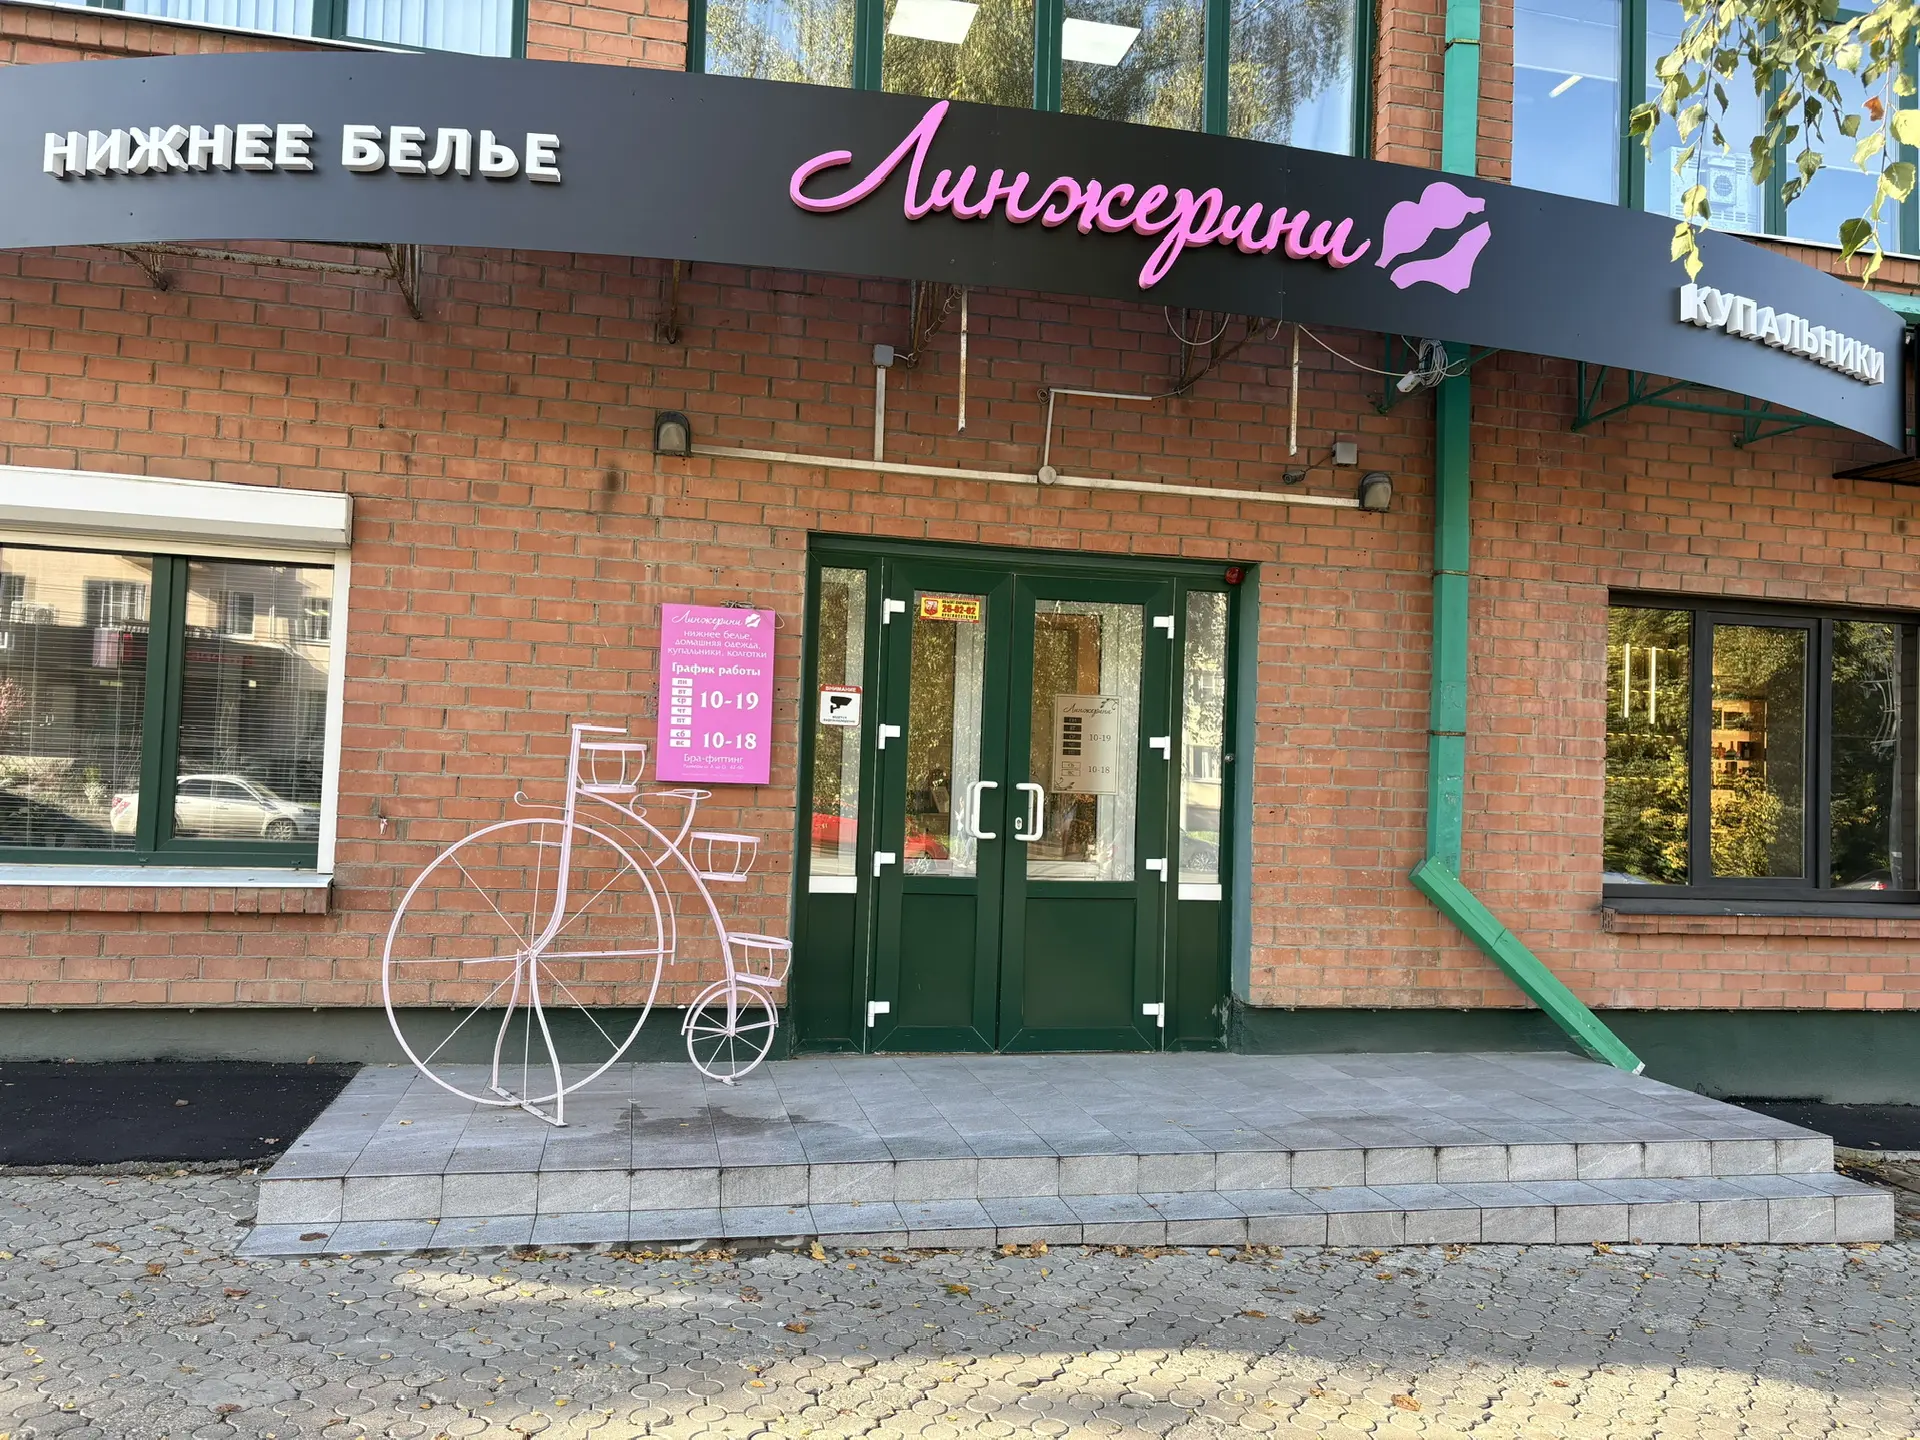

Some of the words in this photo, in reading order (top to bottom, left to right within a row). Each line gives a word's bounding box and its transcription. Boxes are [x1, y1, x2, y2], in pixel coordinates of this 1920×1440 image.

[43, 123, 314, 178] НИЖНЕЕ
[341, 124, 561, 182] БЕЛЬЕ
[789, 100, 1371, 289] Линжерини
[1680, 283, 1884, 385] КУПАЛЬНИКИ
[671, 610, 743, 630] Линжерини
[684, 630, 721, 639] нижнее
[723, 630, 753, 641] белье,
[674, 639, 722, 648] домашняя
[724, 640, 761, 650] одежда,
[667, 647, 724, 657] купальники,
[727, 650, 767, 658] колготки
[672, 662, 715, 676] График
[718, 664, 761, 677] работы
[700, 690, 759, 710] 10-19
[675, 730, 686, 738] сб
[1089, 733, 1111, 742] 10-19
[703, 732, 757, 750] 10-18
[683, 753, 744, 765] Бра-фиттинг
[1088, 765, 1110, 774] 10-18
